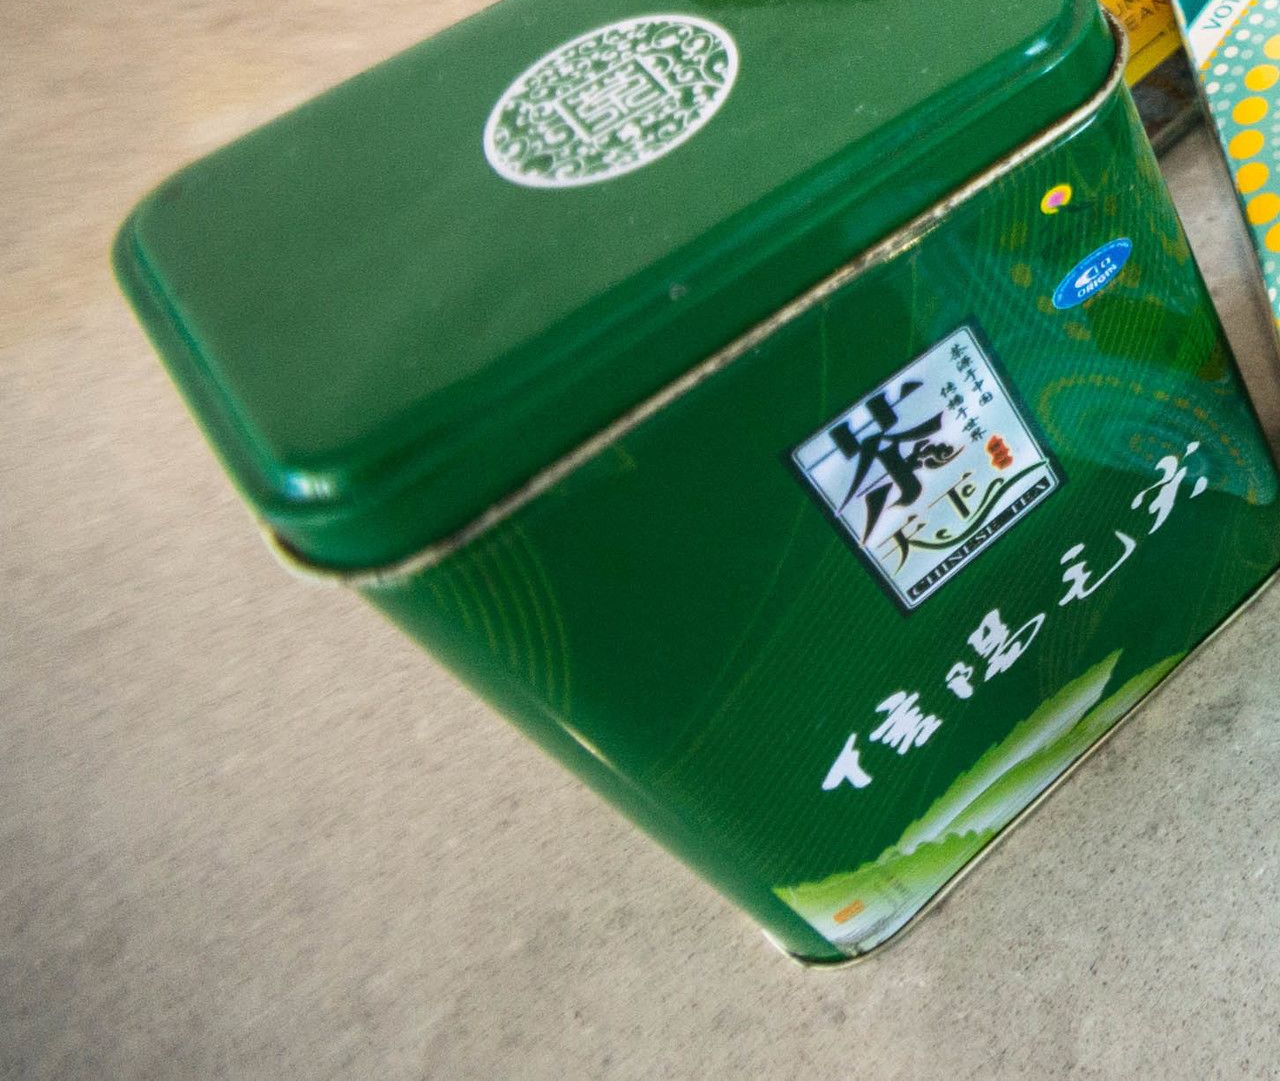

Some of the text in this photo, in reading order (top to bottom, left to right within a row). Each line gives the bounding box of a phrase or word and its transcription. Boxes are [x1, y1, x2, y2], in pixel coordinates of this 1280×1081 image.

[1077, 263, 1118, 299] ORIGIN
[911, 480, 1050, 597] CHINESE TEA
